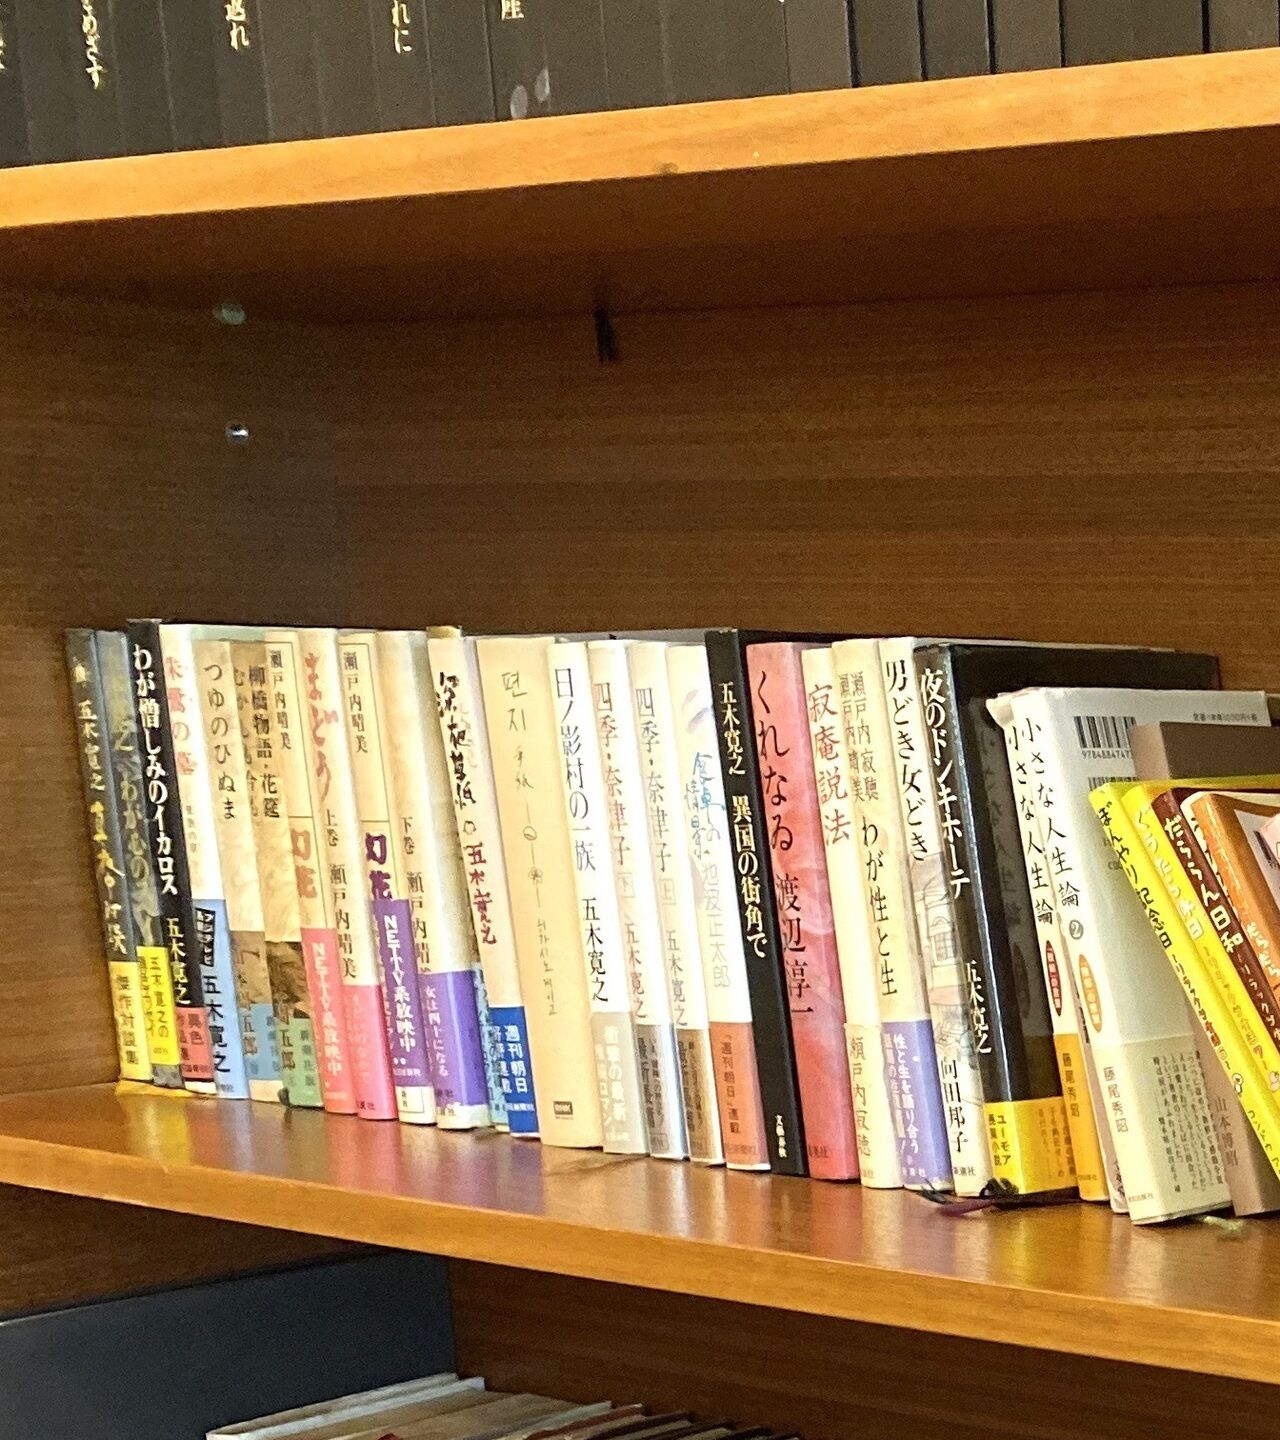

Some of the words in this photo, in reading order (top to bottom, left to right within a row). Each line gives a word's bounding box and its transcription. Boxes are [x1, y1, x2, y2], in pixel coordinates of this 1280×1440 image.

[204, 663, 236, 820] つゆのひぬま
[342, 651, 368, 754] 瀬戸内晴美
[718, 681, 746, 775] 五木寛之
[757, 670, 794, 851] くれなゐ
[886, 659, 929, 861] 男どき女どき
[133, 643, 178, 895] わが憎しみのイカロス
[325, 808, 340, 848] 上巻
[554, 667, 596, 871] 日ノ影村の一族
[593, 681, 630, 866] 四季・奈津子
[635, 687, 673, 873] 四季・奈津子
[808, 684, 851, 847] 寂庵説法
[920, 667, 971, 900] 夜のドンキホーテ
[1008, 725, 1054, 925] 小さな人生論
[1022, 717, 1081, 908] 小さな人生論
[400, 816, 416, 855] 下巻
[731, 795, 769, 959] 異国の街角で
[1098, 801, 1172, 949] ぼんやり記念日
[1164, 815, 1244, 953] だららん日和
[165, 917, 191, 1005] 五木寛之
[329, 864, 358, 979] 瀬戸内晴美
[406, 871, 432, 973] 瀬戸内晴
[581, 897, 609, 1003] 五木寛之
[702, 863, 732, 988] 池波正太郎
[776, 873, 814, 1015] 渡辺淳一
[862, 815, 898, 996] わが性と生
[203, 975, 231, 1073] 五木寛之
[624, 922, 647, 1019] 五木寛之
[666, 928, 688, 1027] 五木寛之
[965, 959, 992, 1055] 五木寛之
[504, 1024, 528, 1094] 週刊朝日
[940, 1059, 969, 1154] 向田邦子
[1061, 1052, 1081, 1118] 藤尾秀昭
[1103, 1066, 1129, 1133] 藤尾秀昭
